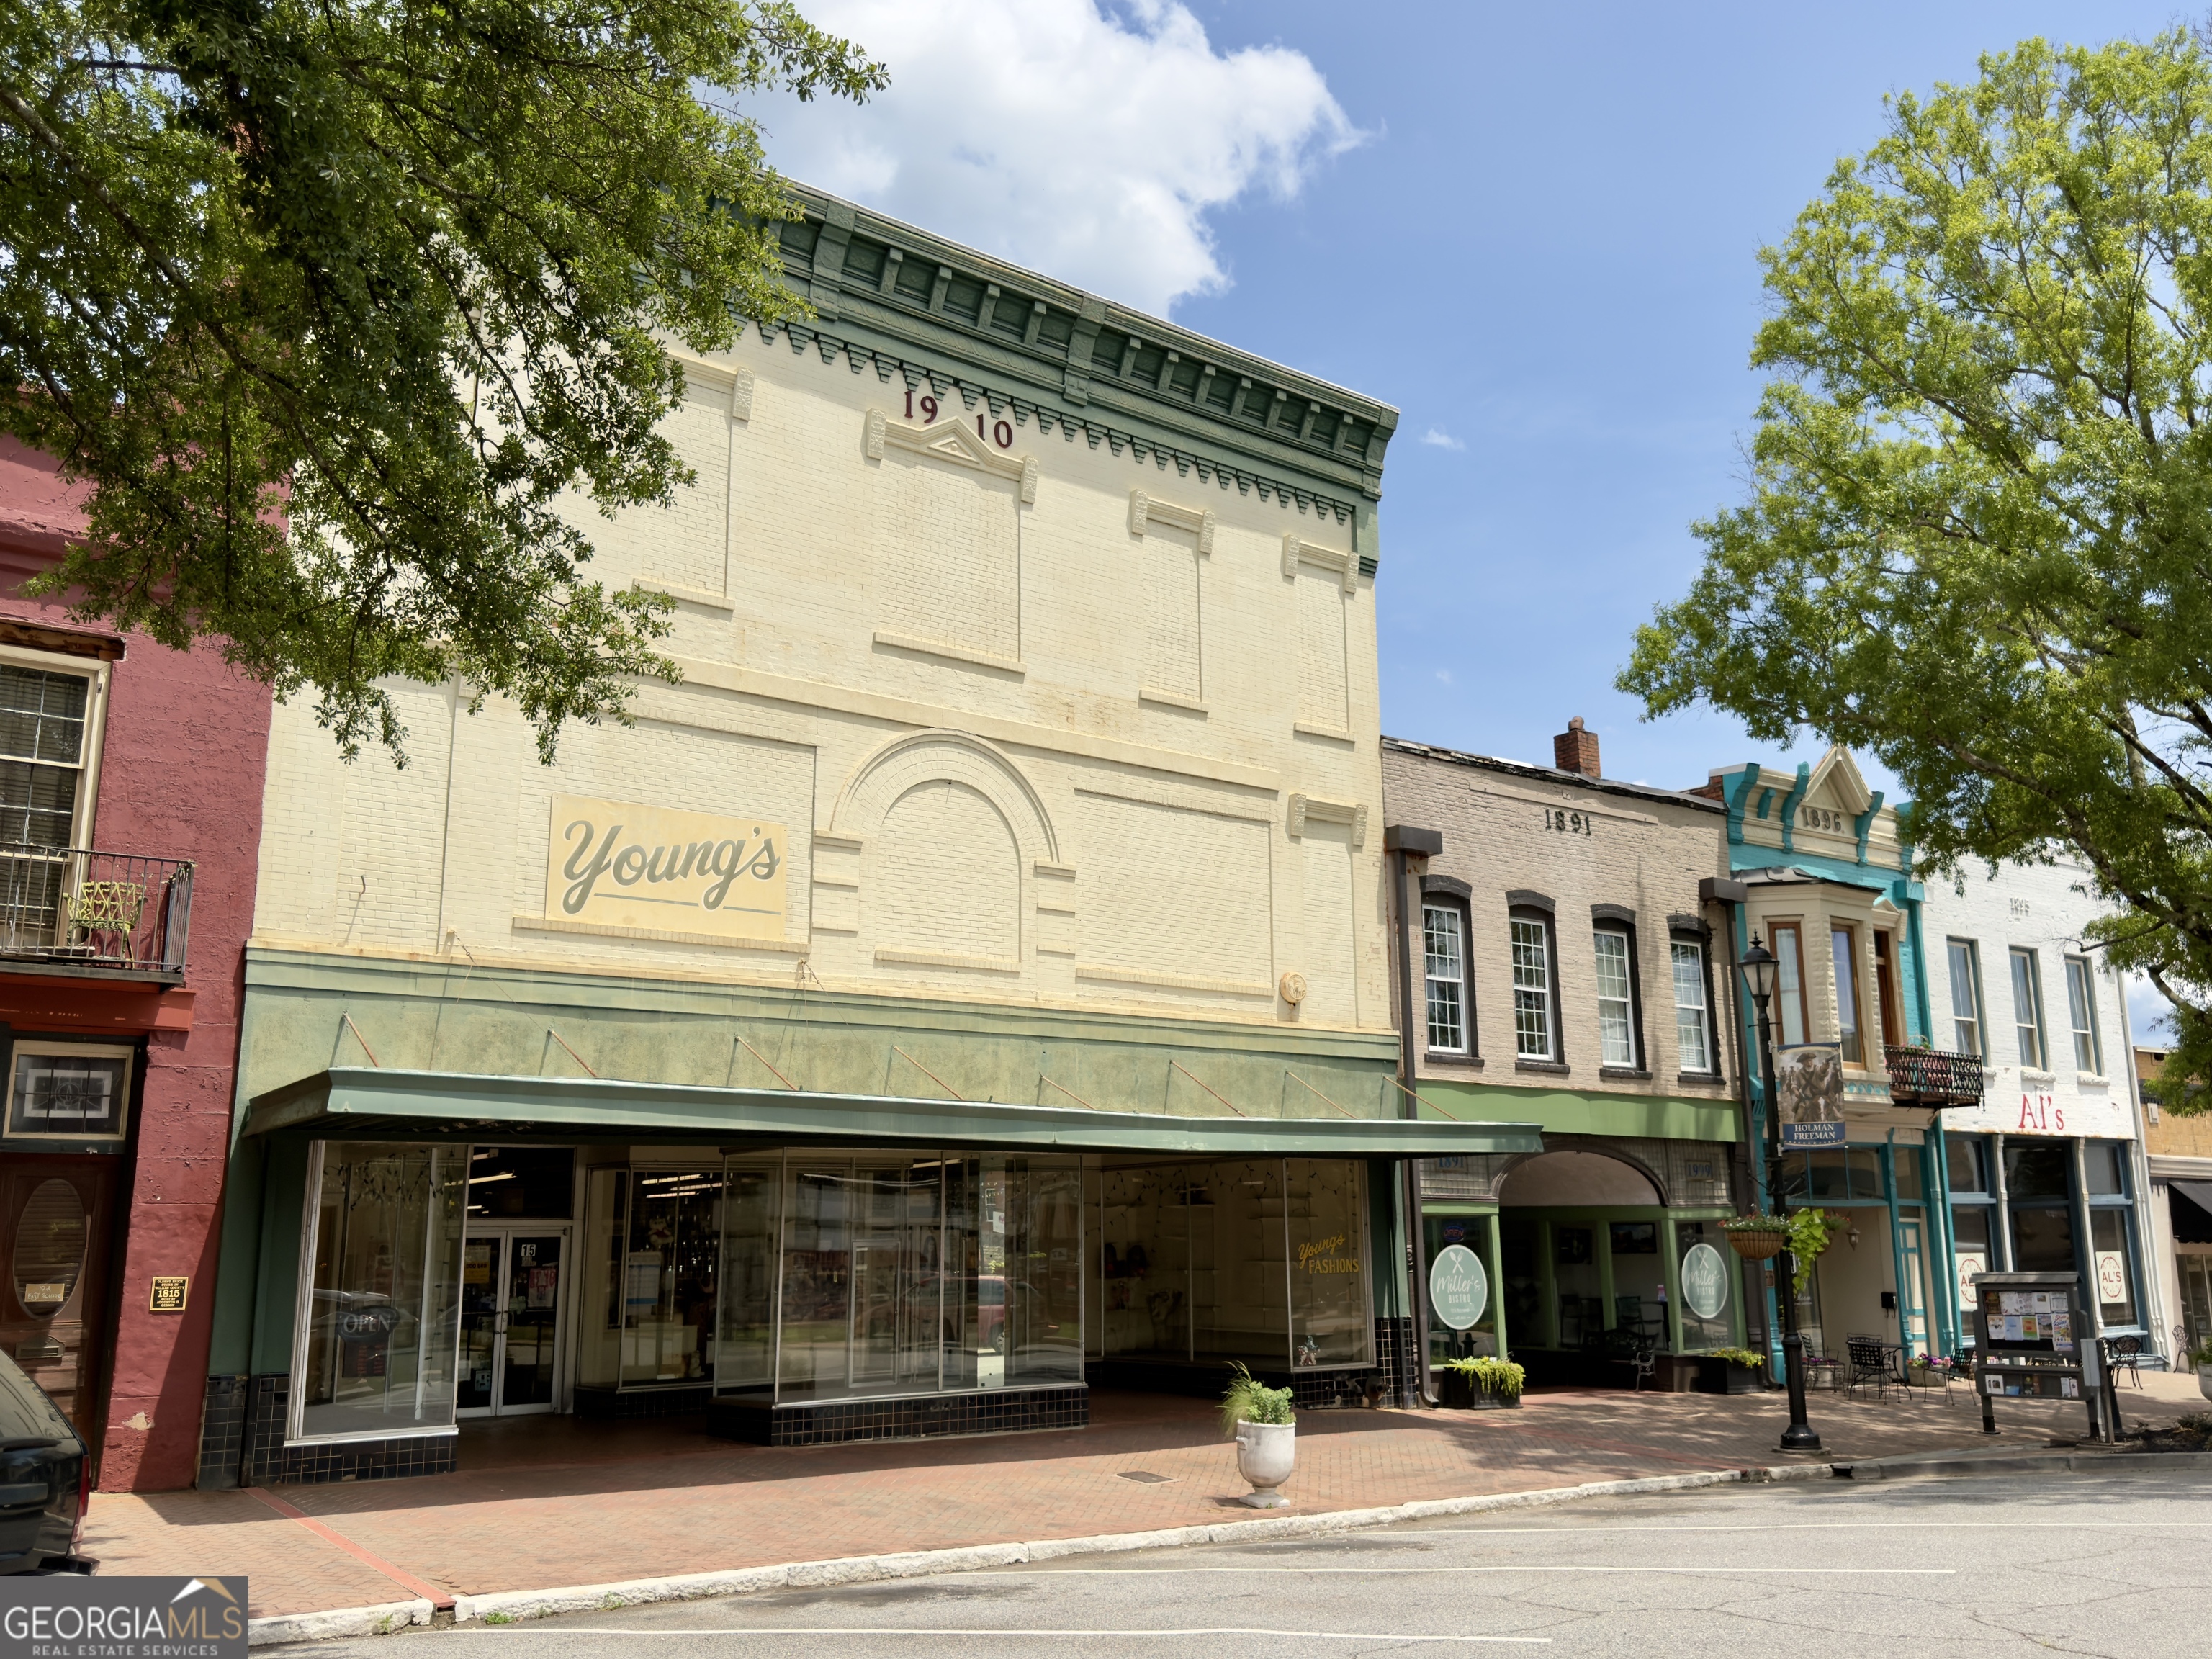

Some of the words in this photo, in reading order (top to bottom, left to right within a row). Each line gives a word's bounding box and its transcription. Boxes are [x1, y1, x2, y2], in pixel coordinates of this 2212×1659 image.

[1545, 808, 1591, 837] 1891
[562, 819, 781, 914] Young's
[2018, 1093, 2064, 1130] Al's
[1794, 1123, 1835, 1132] HOLMAN
[1794, 1131, 1835, 1140] FREEMAN
[1444, 1228, 1464, 1237] OPEN
[523, 1245, 535, 1256] 15
[1308, 1259, 1360, 1274] FASHIONS
[1436, 1274, 1481, 1293] Miller's
[1686, 1269, 1722, 1287] Miller's
[2102, 1271, 2122, 1282] AL'S
[1448, 1294, 1471, 1303] BISTRO
[343, 1314, 390, 1333] OPEN
